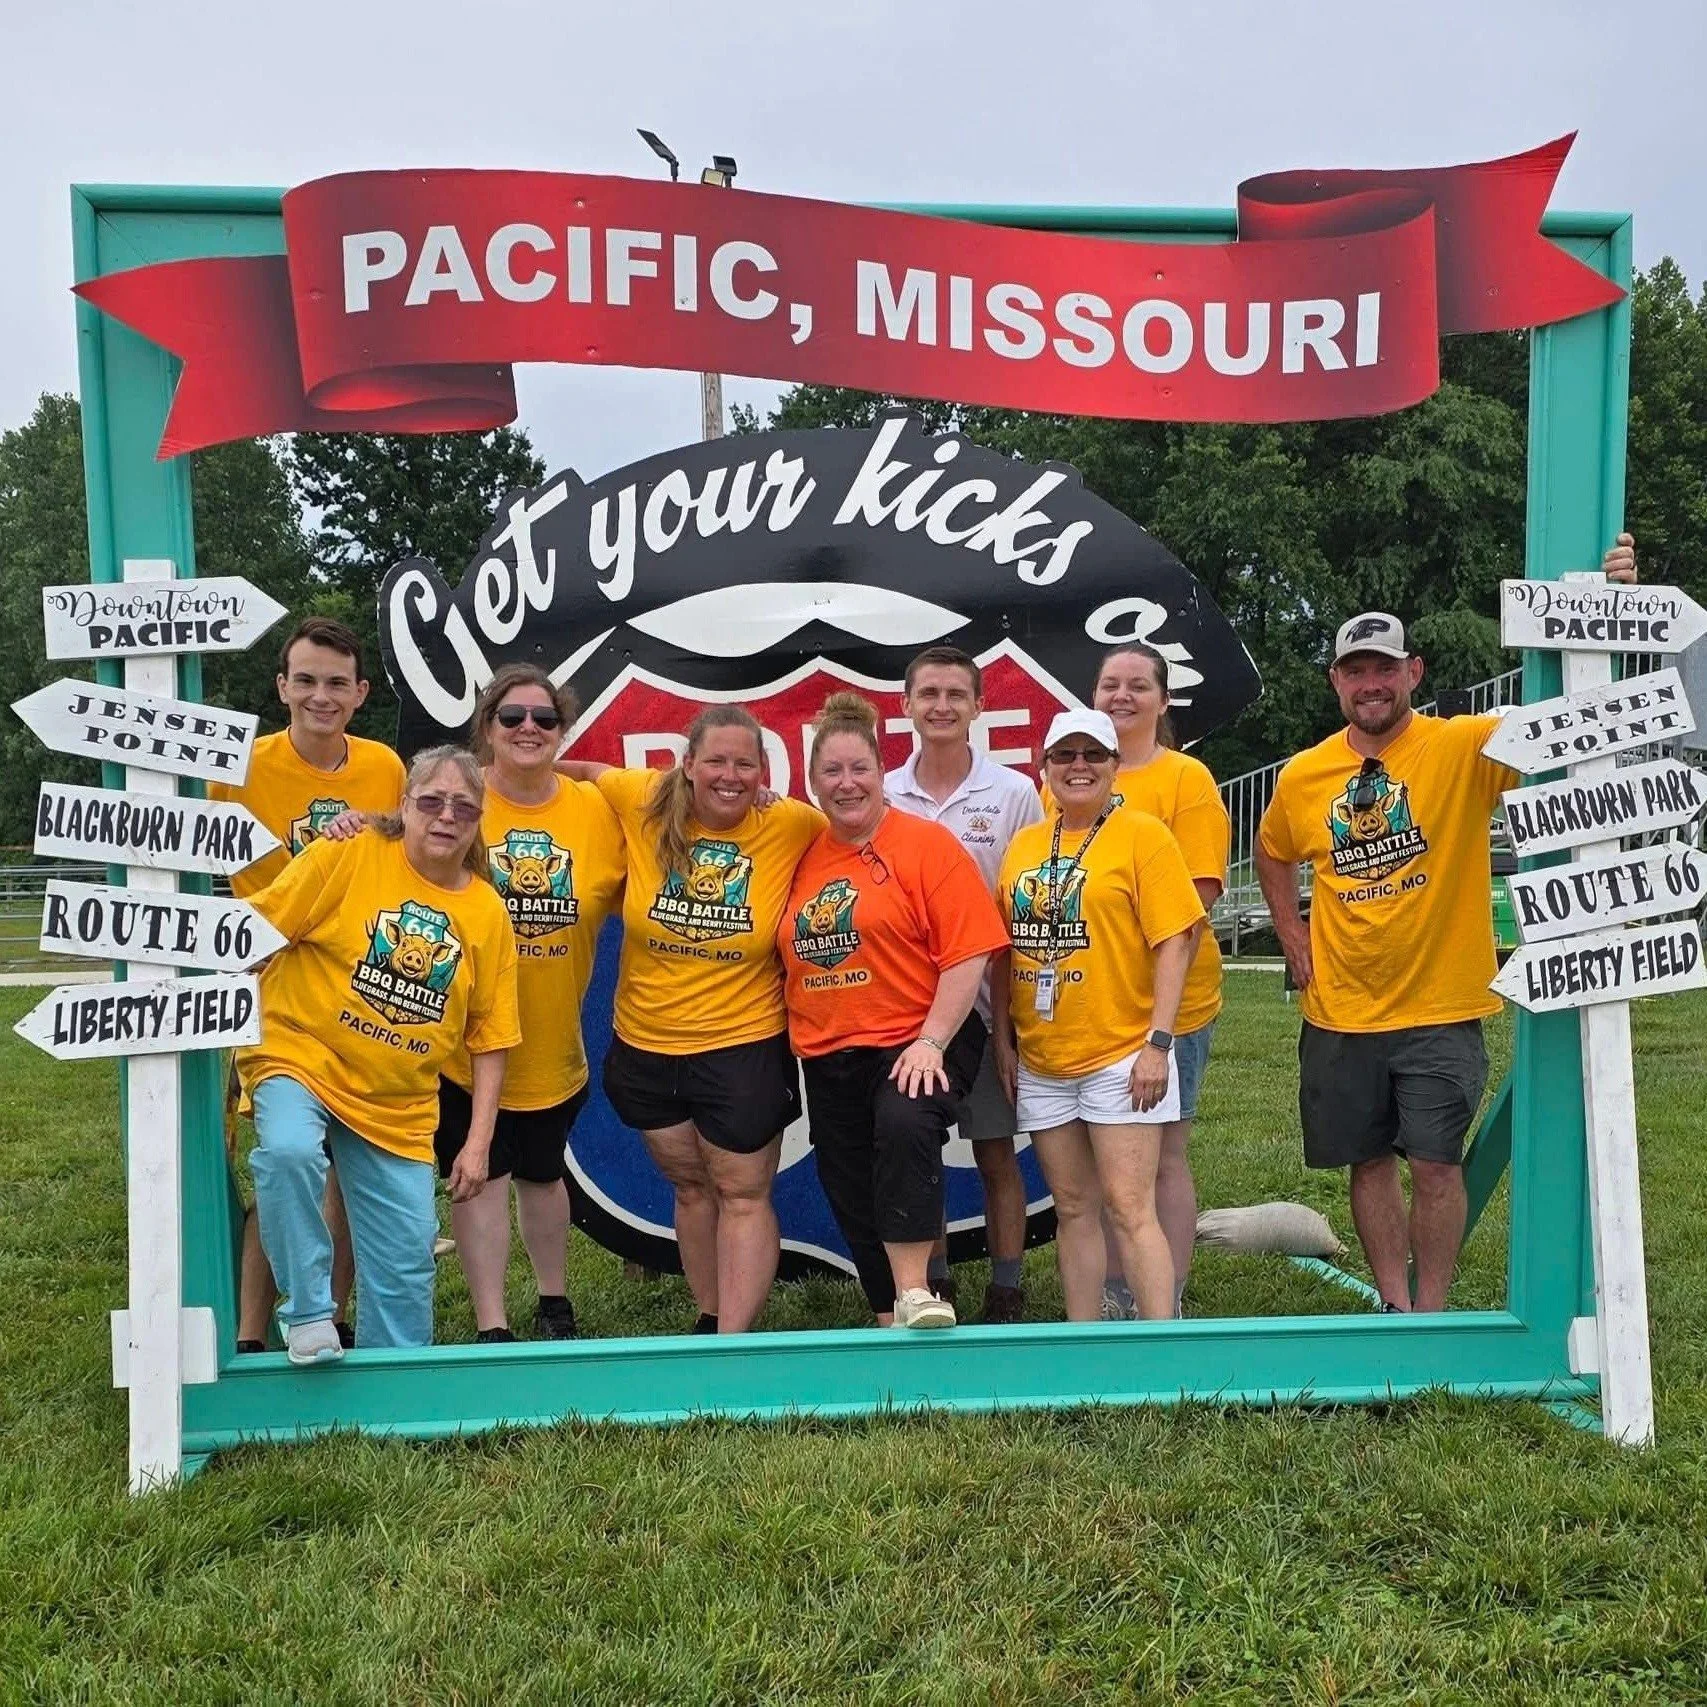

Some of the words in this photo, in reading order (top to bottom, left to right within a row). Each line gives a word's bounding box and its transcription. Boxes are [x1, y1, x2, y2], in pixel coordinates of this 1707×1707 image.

[342, 223, 814, 344] PACIFIC,
[856, 260, 1381, 376] MISSOURI
[389, 480, 568, 728] Get
[589, 448, 816, 602] your
[832, 417, 1094, 586] kicks
[47, 585, 246, 627] Downtown
[1508, 583, 1683, 620] Downtown
[88, 618, 231, 650] PACIFIC
[1544, 616, 1670, 643] PACIFIC
[67, 693, 251, 744] JENSEN
[1523, 684, 1677, 741] JENSEN
[82, 725, 239, 770] POINT
[1545, 711, 1680, 760] POINT
[315, 803, 345, 813] ROUTE
[1507, 779, 1638, 844] BLACKBURN
[1641, 768, 1701, 817] PARK
[38, 793, 185, 853] BLACKBURN
[192, 813, 255, 862] PARK
[511, 833, 545, 842] ROUTE
[961, 831, 997, 847] Cleaning
[515, 843, 545, 859] 66
[699, 850, 727, 867] 66
[1334, 846, 1366, 864] BBQ
[1366, 829, 1420, 857] BATTLE
[1398, 843, 1426, 857] FESTIVAL
[821, 890, 840, 905] 66
[1338, 883, 1398, 903] PACIFIC,
[1401, 874, 1426, 890] MO
[1514, 860, 1655, 927] ROUTE
[1664, 850, 1701, 897] 66
[408, 905, 444, 925] ROUTE
[522, 898, 576, 914] BATTLE
[657, 897, 689, 915] BBQ
[692, 903, 748, 921] BATTLE
[42, 893, 199, 954] ROUTE
[213, 911, 253, 960] 66
[405, 918, 436, 942] 66
[723, 922, 751, 930] FESTIVAL
[1012, 923, 1039, 937] BBQ
[1041, 923, 1083, 937] BTTLE
[549, 945, 568, 957] MO
[649, 939, 713, 960] PACIFIC,
[716, 950, 742, 961] MO
[794, 939, 817, 953] BBQ
[818, 932, 858, 949] BATTLE
[805, 974, 843, 989] PACIFIC,
[845, 971, 867, 983] MO
[1525, 946, 1624, 1003] LIBERTY
[1630, 931, 1699, 984] FIELD
[358, 964, 393, 990] BBQ
[395, 979, 445, 1008] BATTLE
[388, 994, 402, 1006] AND
[53, 994, 170, 1046] LIBERTY
[175, 987, 253, 1038] FIELD
[339, 1010, 402, 1049] PACIFIC,
[407, 1038, 430, 1055] MO
